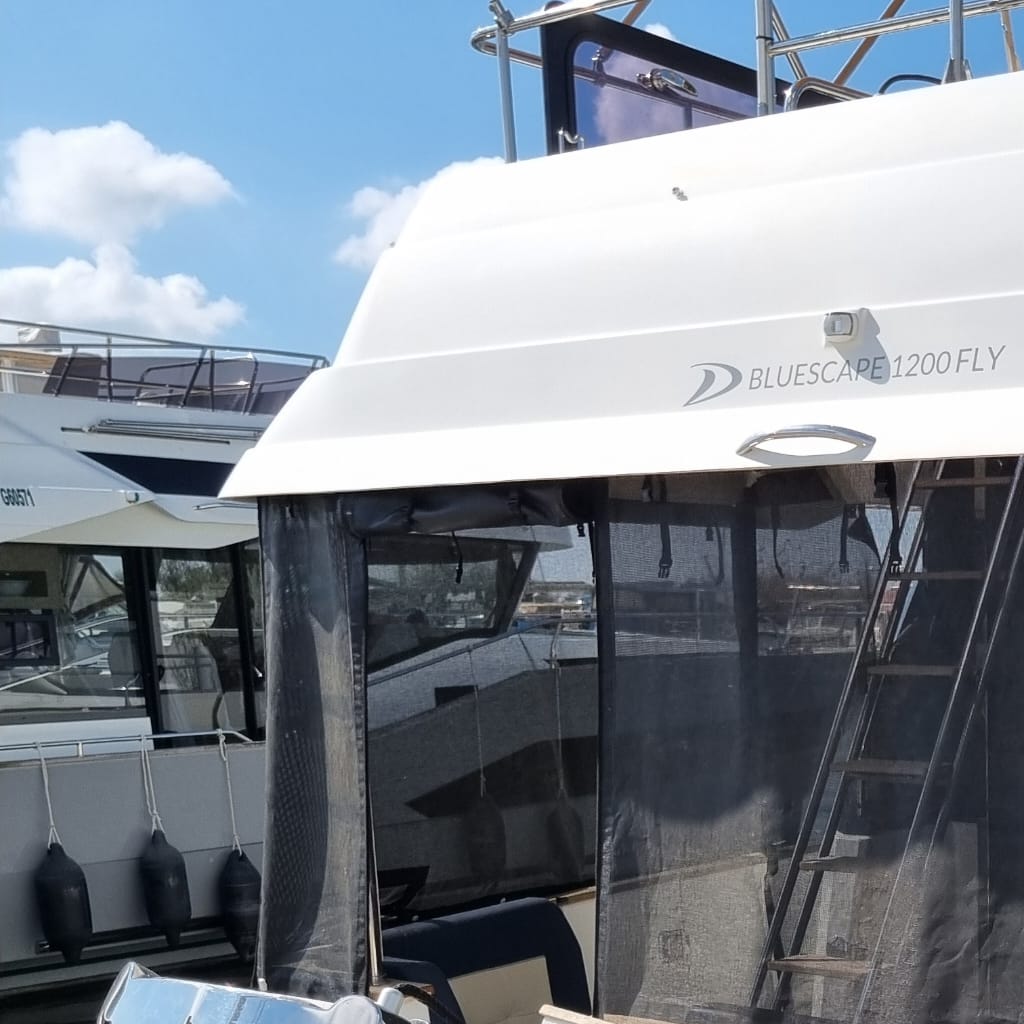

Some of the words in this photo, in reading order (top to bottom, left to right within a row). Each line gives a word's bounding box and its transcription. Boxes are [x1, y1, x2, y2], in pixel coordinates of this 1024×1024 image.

[749, 356, 886, 390] BLUESCAPE
[892, 351, 951, 378] 1200
[955, 345, 1006, 373] FLY
